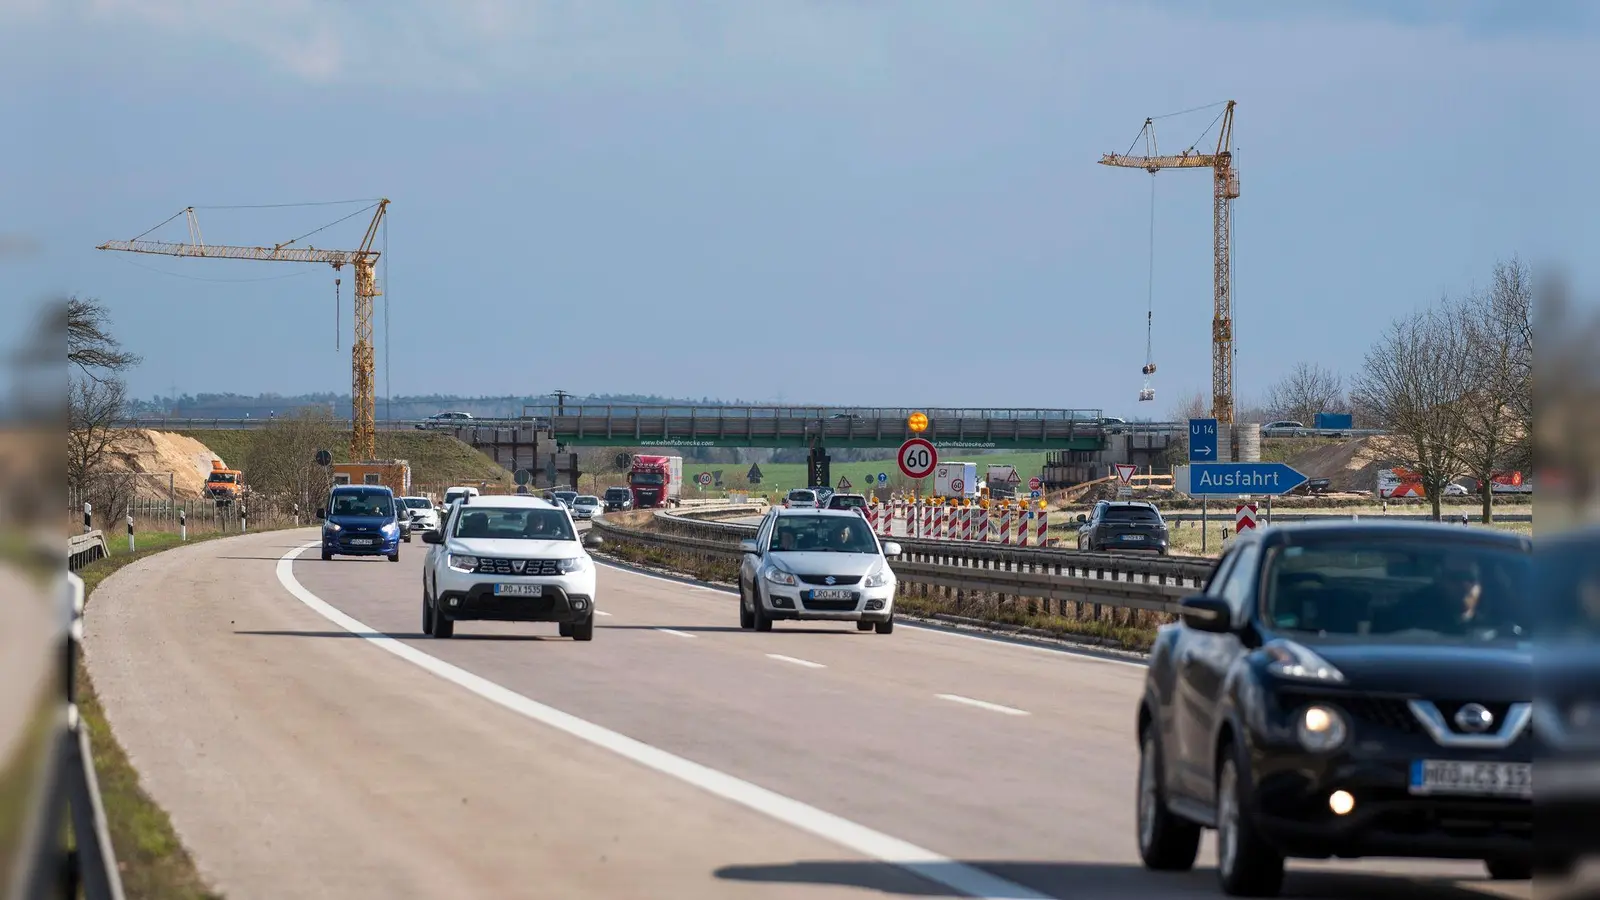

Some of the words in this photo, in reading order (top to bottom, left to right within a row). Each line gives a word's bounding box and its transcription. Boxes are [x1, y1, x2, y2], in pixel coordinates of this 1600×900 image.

[1192, 425, 1200, 435] U
[1204, 424, 1214, 435] 14
[906, 449, 929, 468] 60
[1199, 470, 1279, 486] Ausfahrt
[500, 584, 513, 593] LRO
